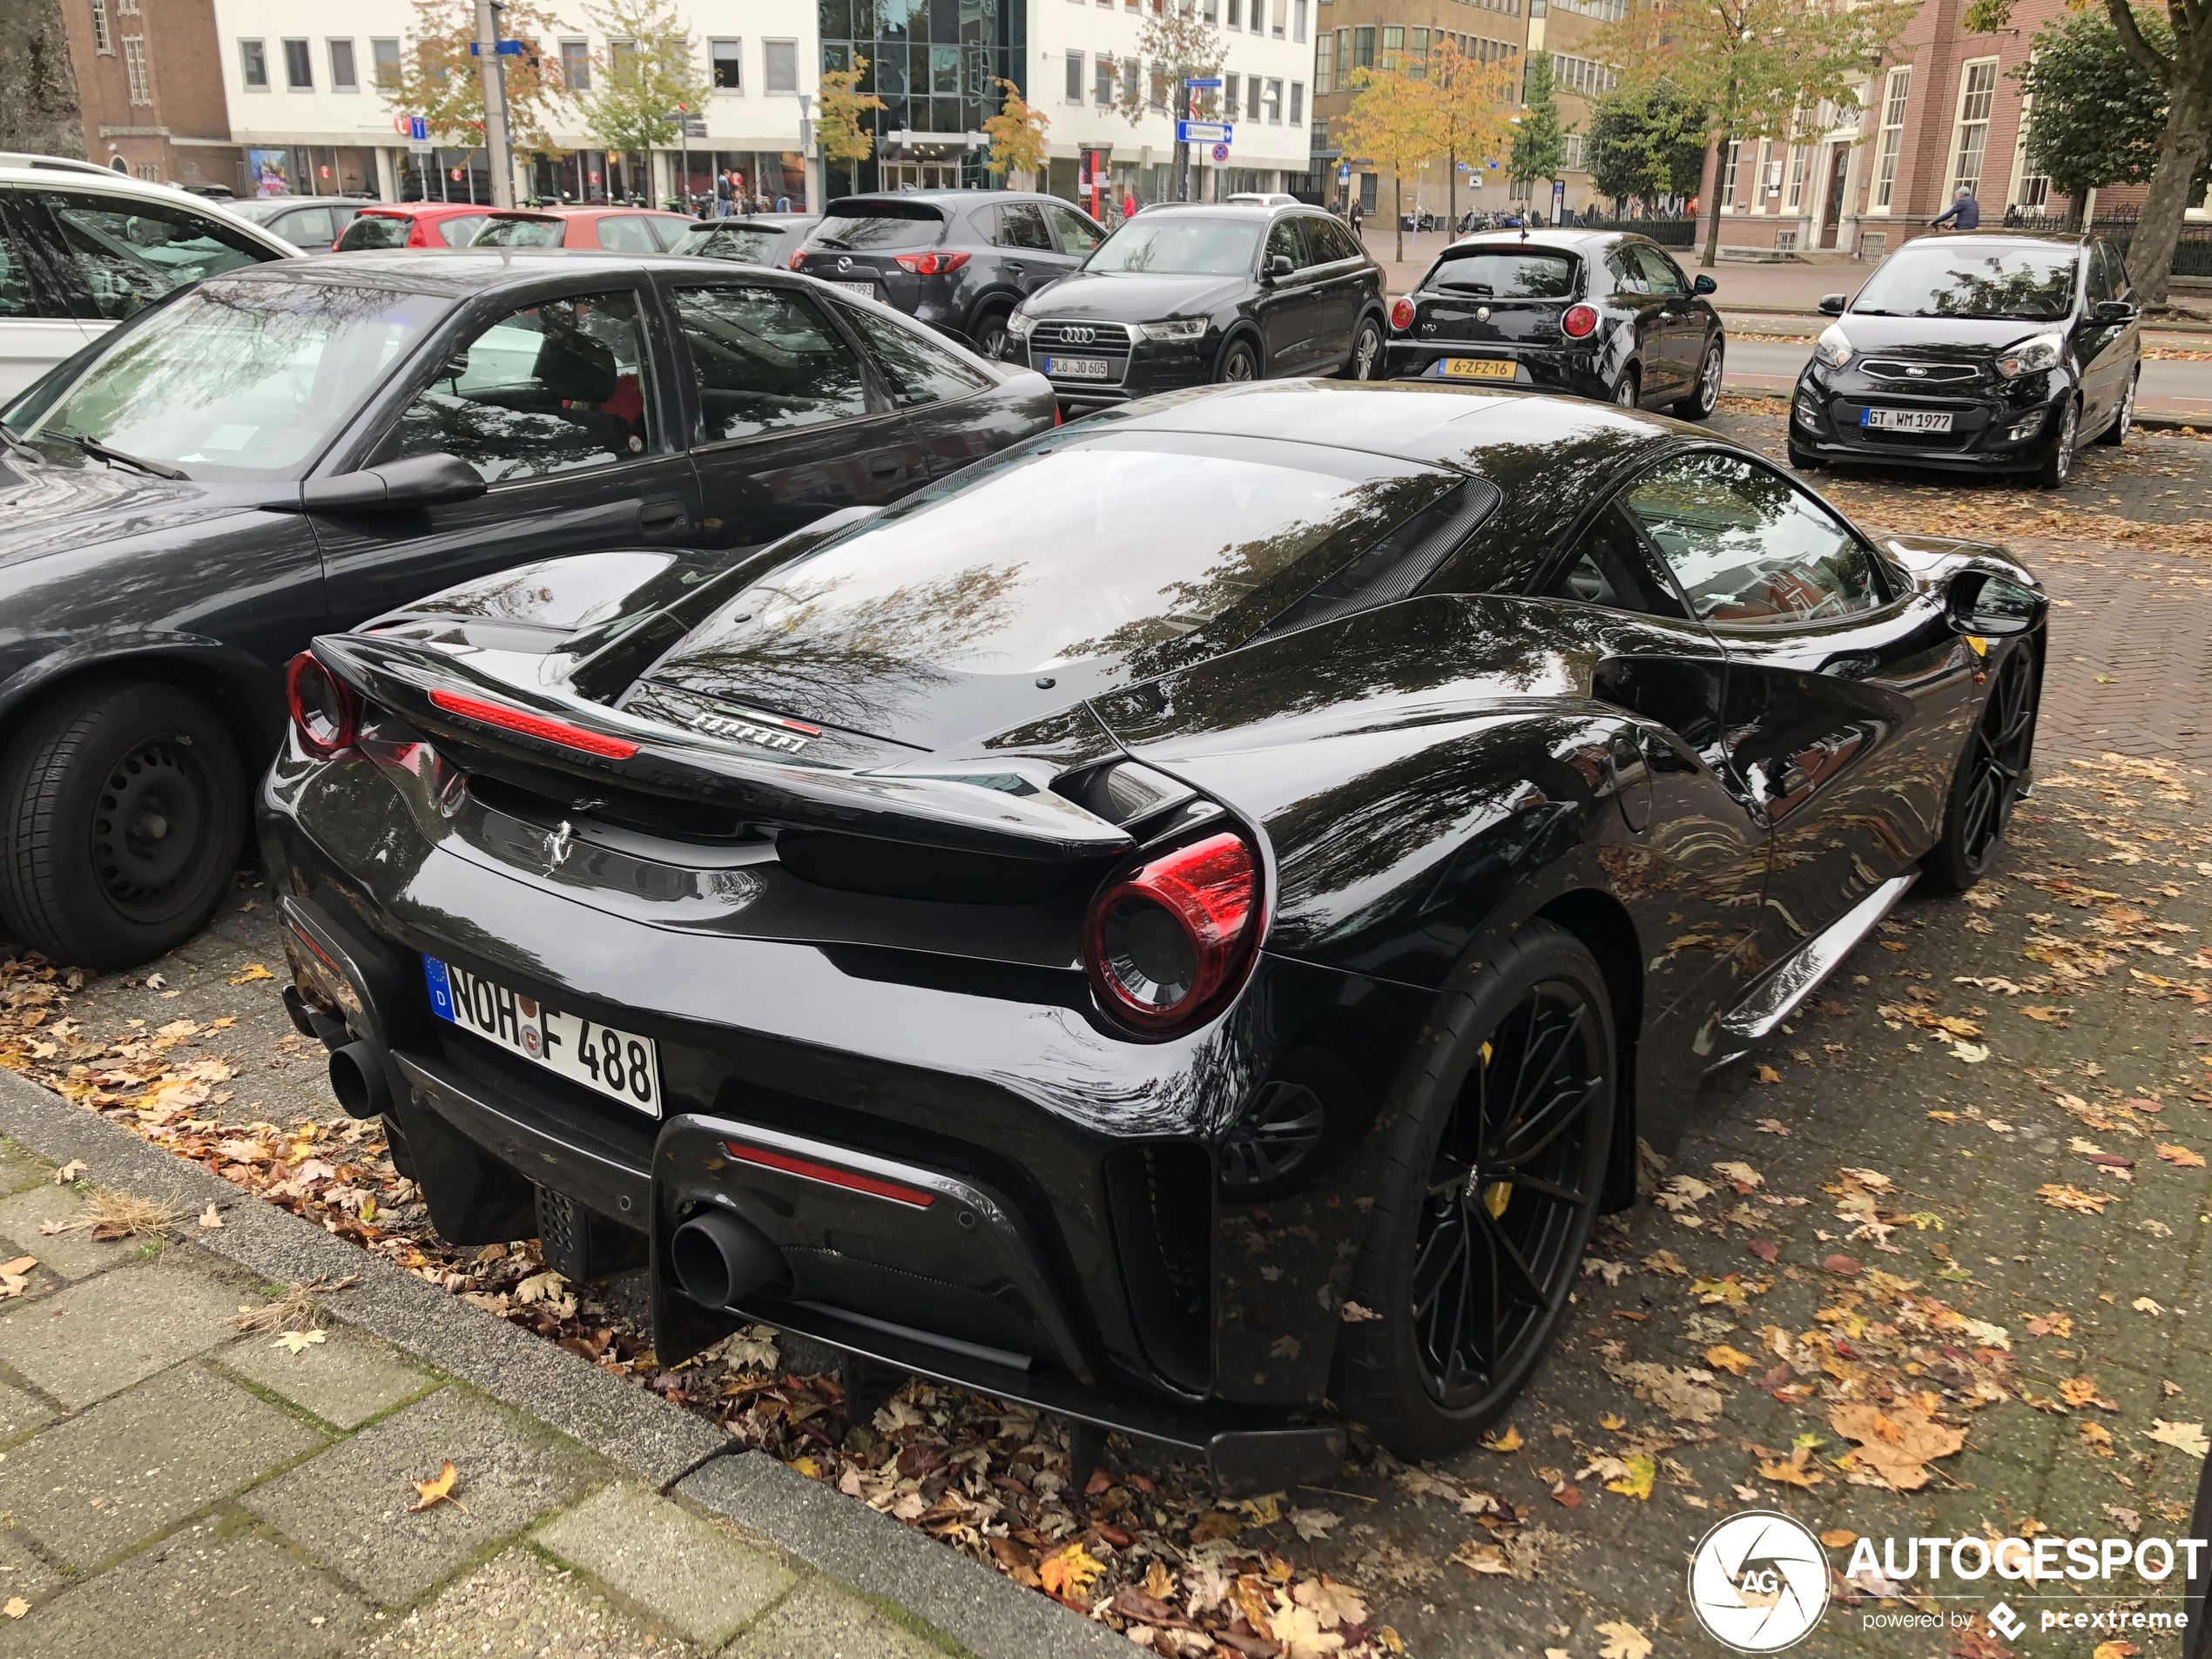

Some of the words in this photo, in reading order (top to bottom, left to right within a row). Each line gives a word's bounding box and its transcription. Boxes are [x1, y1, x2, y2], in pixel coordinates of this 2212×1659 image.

[856, 284, 872, 295] 993
[1051, 360, 1068, 372] PLÖ
[1075, 361, 1086, 373] JO
[1089, 362, 1106, 374] 605
[1453, 360, 1507, 375] 6-ZFZ-16
[1870, 411, 1886, 425] GT
[1897, 412, 1913, 427] WM
[1915, 414, 1950, 428] 1977
[688, 713, 808, 753] Ferrari
[451, 965, 521, 1047] NOH
[539, 1002, 562, 1060] F
[578, 1019, 651, 1103] 488
